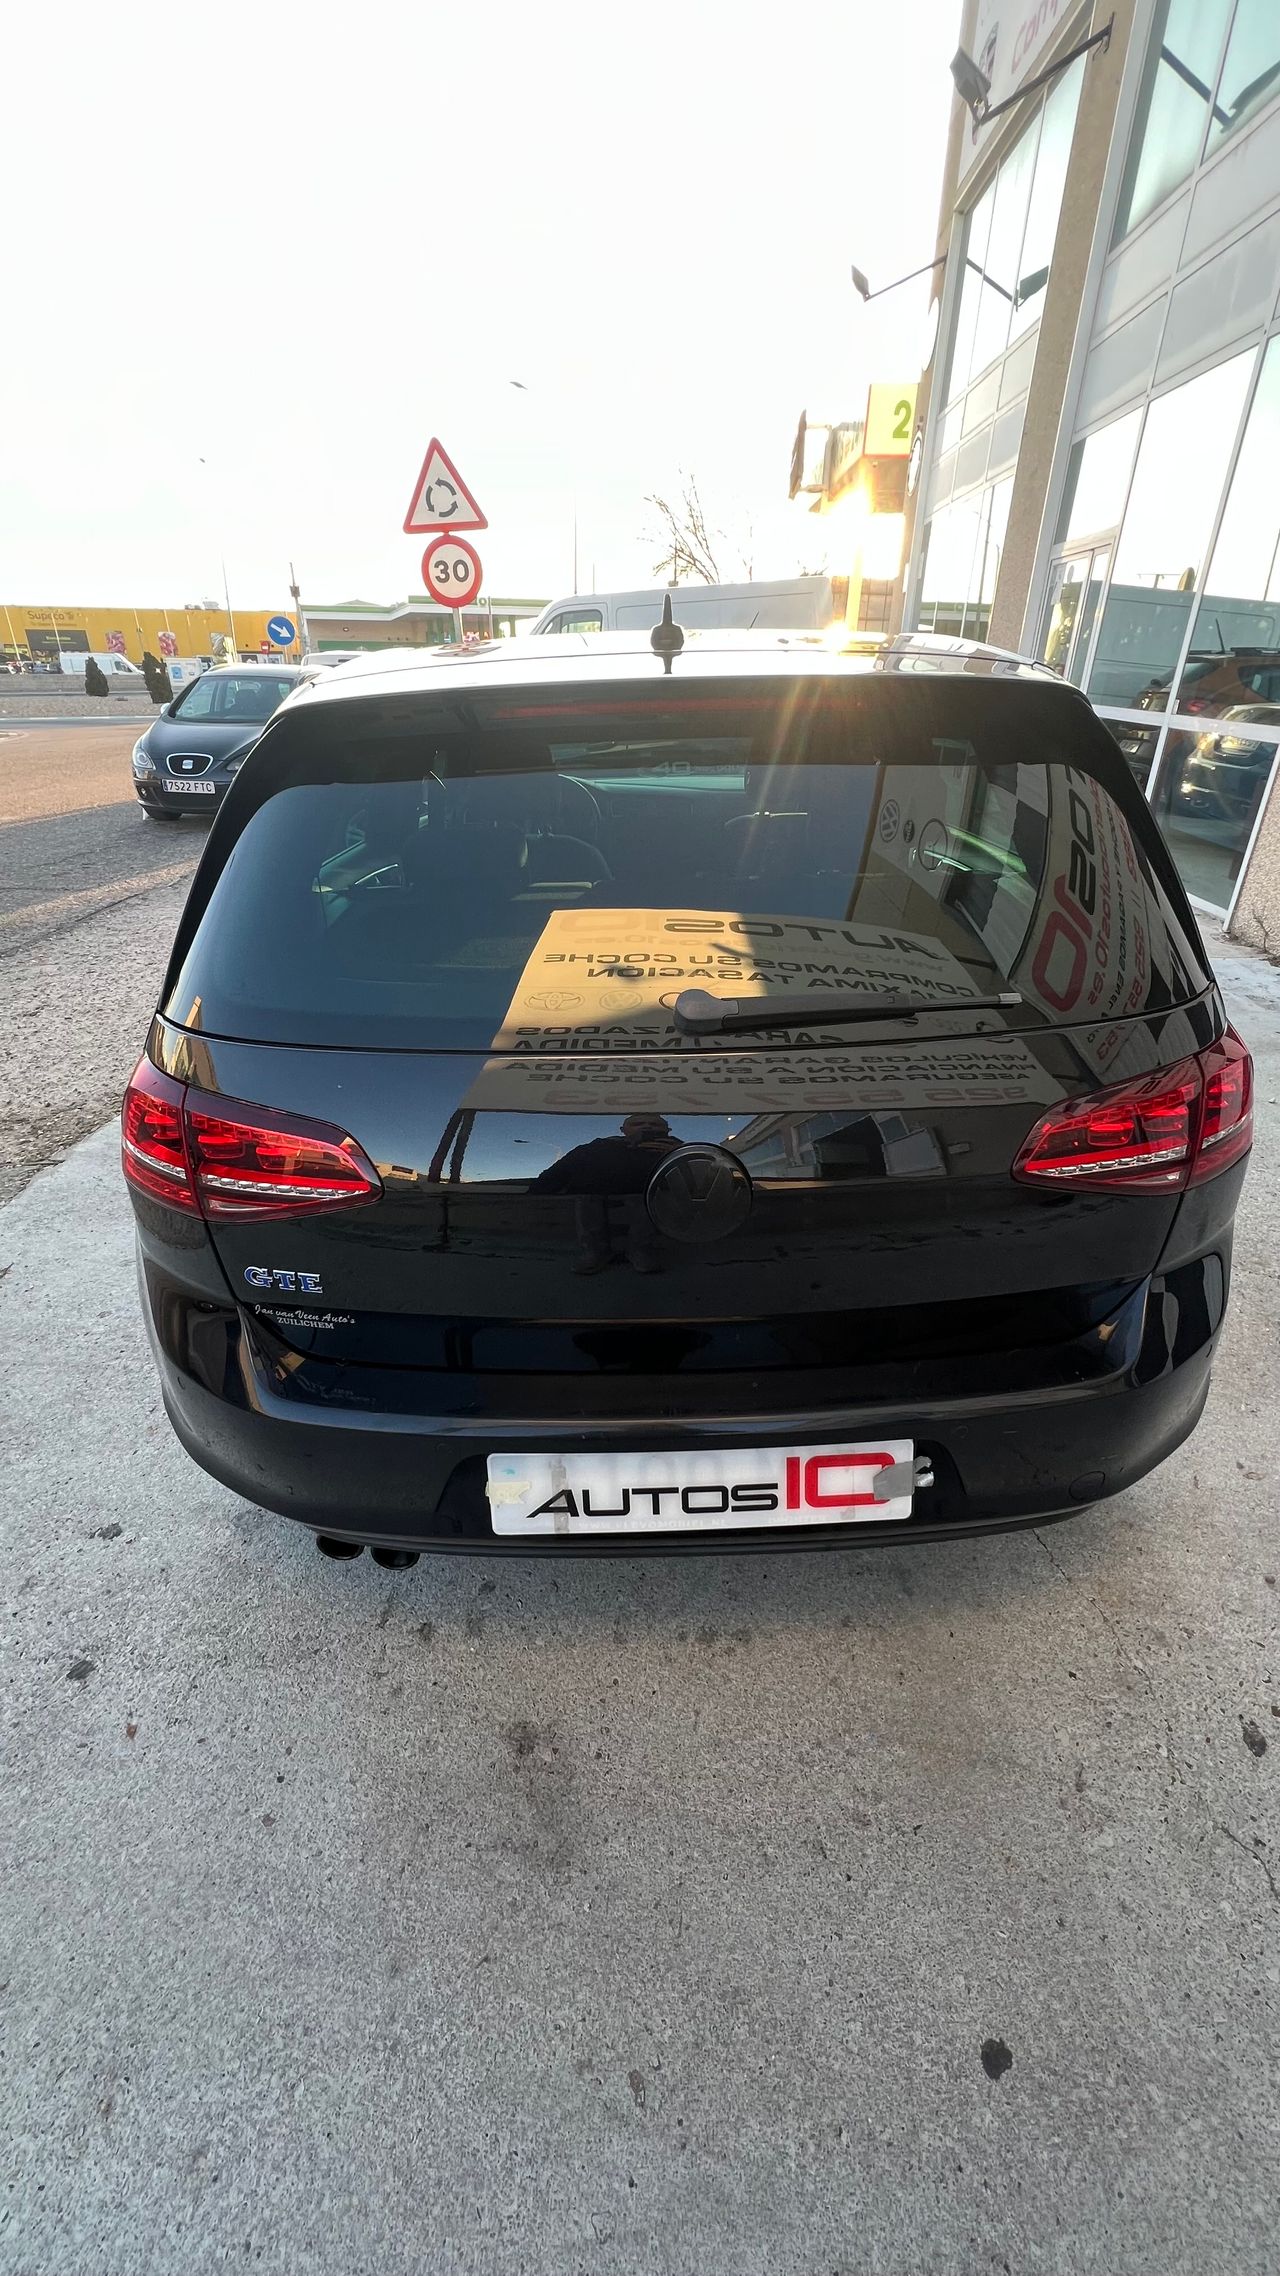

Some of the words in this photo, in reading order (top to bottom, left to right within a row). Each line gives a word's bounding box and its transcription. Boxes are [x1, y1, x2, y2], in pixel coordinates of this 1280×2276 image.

[892, 400, 911, 438] 2
[433, 560, 470, 584] 30
[168, 781, 192, 792] 7522
[194, 783, 212, 792] FTC
[243, 1266, 323, 1293] GTE
[255, 1304, 274, 1315] Jan
[295, 1310, 320, 1321] Veen
[277, 1317, 335, 1330] ZUILICHEM
